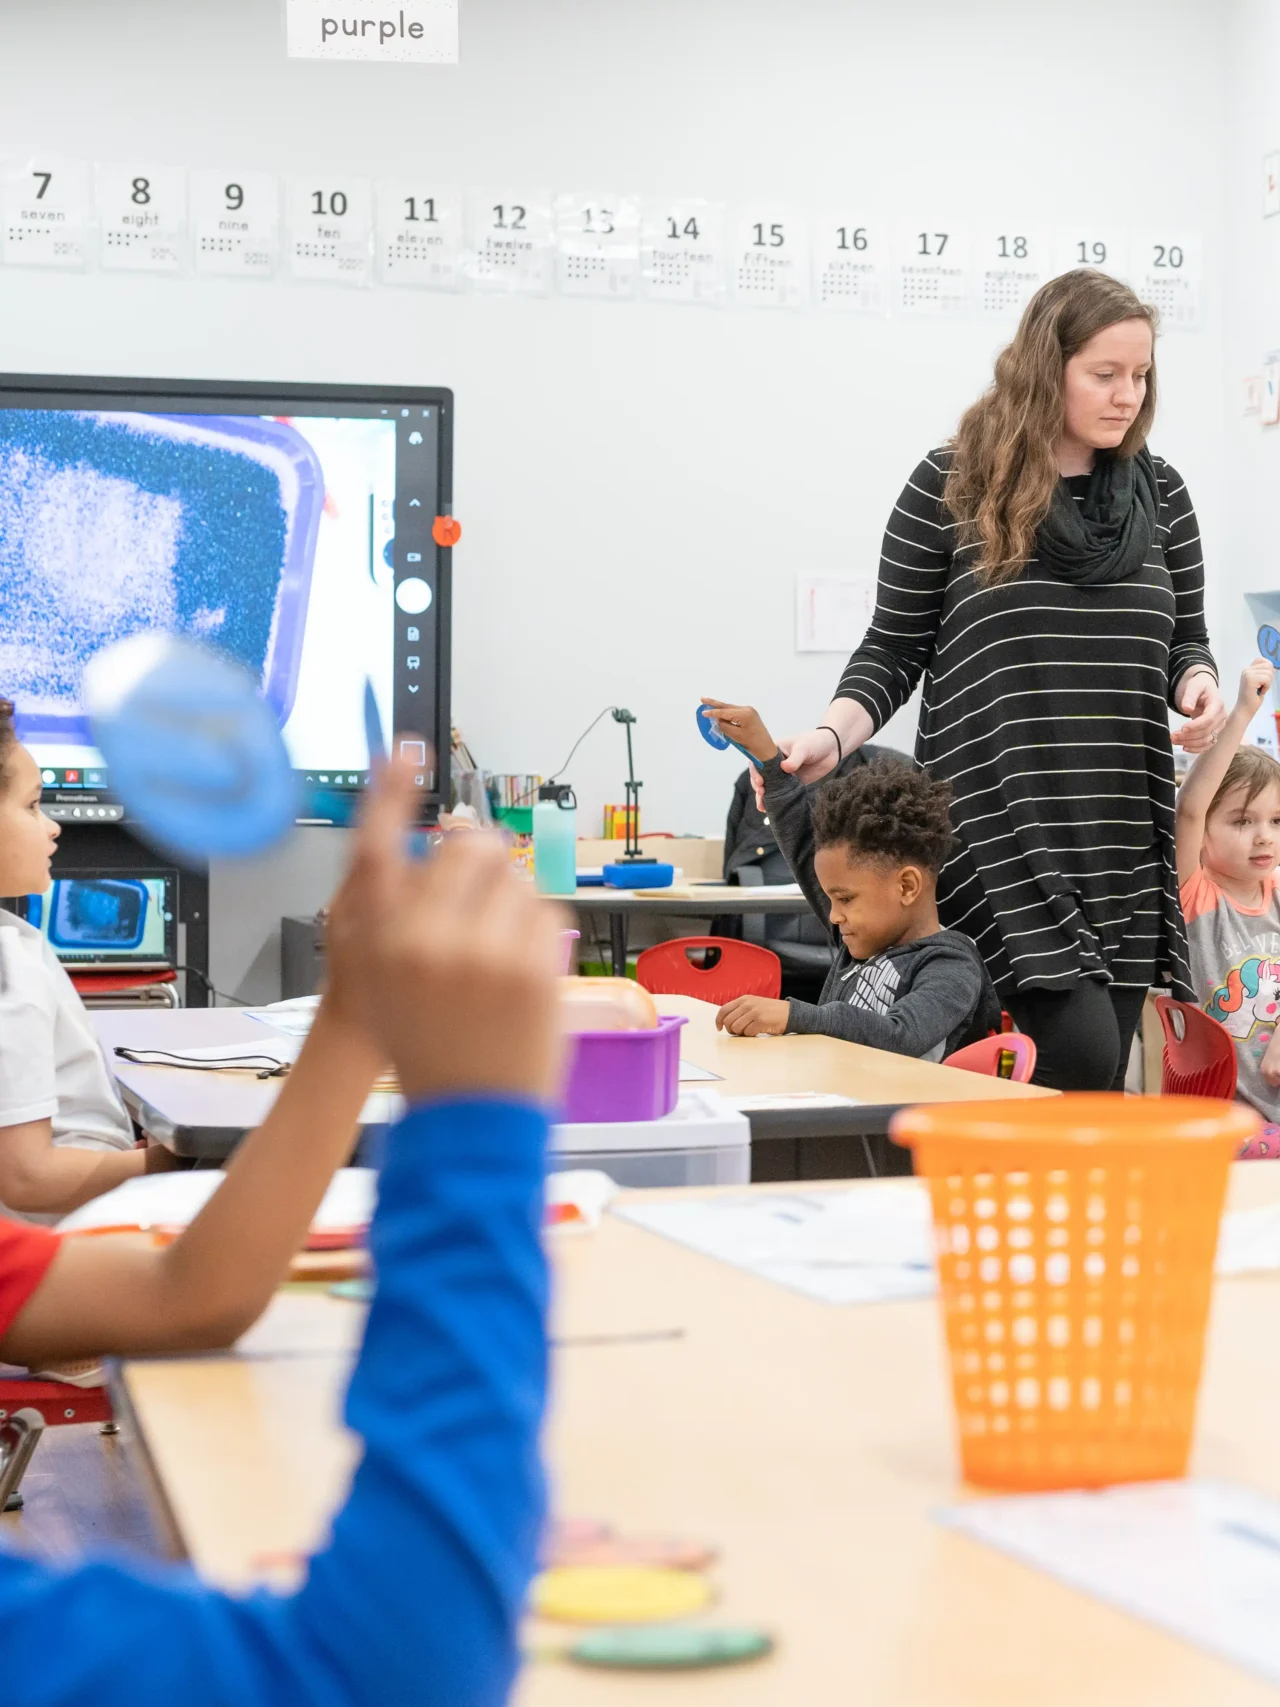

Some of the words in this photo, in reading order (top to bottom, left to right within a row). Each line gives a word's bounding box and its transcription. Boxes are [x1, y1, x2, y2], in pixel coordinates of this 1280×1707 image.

[321, 10, 424, 45] purple
[33, 172, 52, 199] 7
[131, 177, 151, 204] 8
[225, 183, 244, 211] 9
[311, 191, 347, 216] 10
[404, 197, 439, 222] 11
[21, 210, 66, 222] seven
[122, 212, 160, 227] eight
[219, 220, 249, 231] nine
[492, 205, 527, 230] 12
[583, 208, 615, 234] 13
[667, 216, 700, 240] 14
[317, 225, 340, 240] ten
[397, 231, 443, 246] eleven
[486, 237, 532, 251] twelve
[752, 223, 785, 247] 15
[836, 227, 868, 251] 16
[917, 233, 949, 256] 17
[996, 235, 1028, 259] 18
[1076, 241, 1107, 264] 19
[1153, 245, 1184, 268] 20
